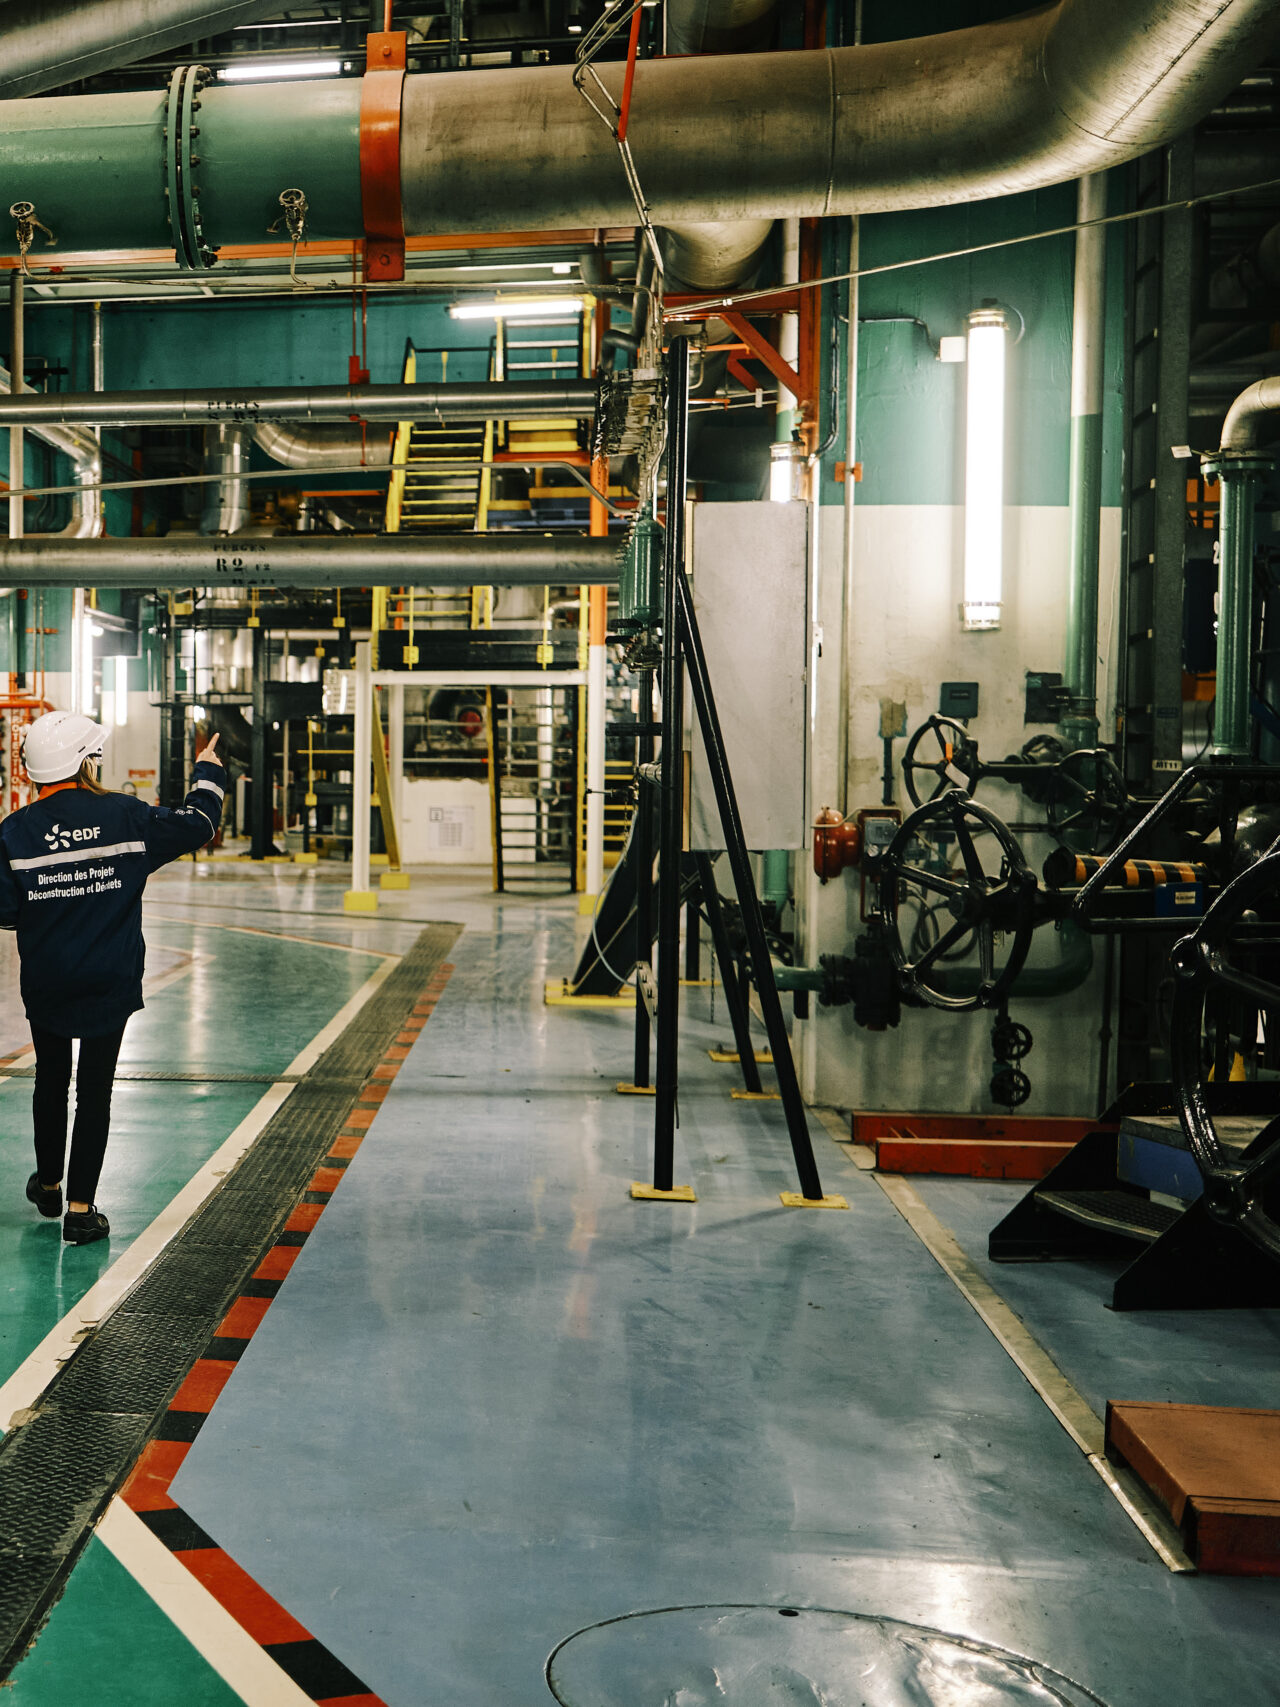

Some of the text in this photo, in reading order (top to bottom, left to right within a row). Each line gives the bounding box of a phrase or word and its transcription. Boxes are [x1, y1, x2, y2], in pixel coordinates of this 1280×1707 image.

[38, 866, 115, 886] Direction des Projets
[28, 886, 85, 901] Déconstruction
[86, 883, 94, 893] et
